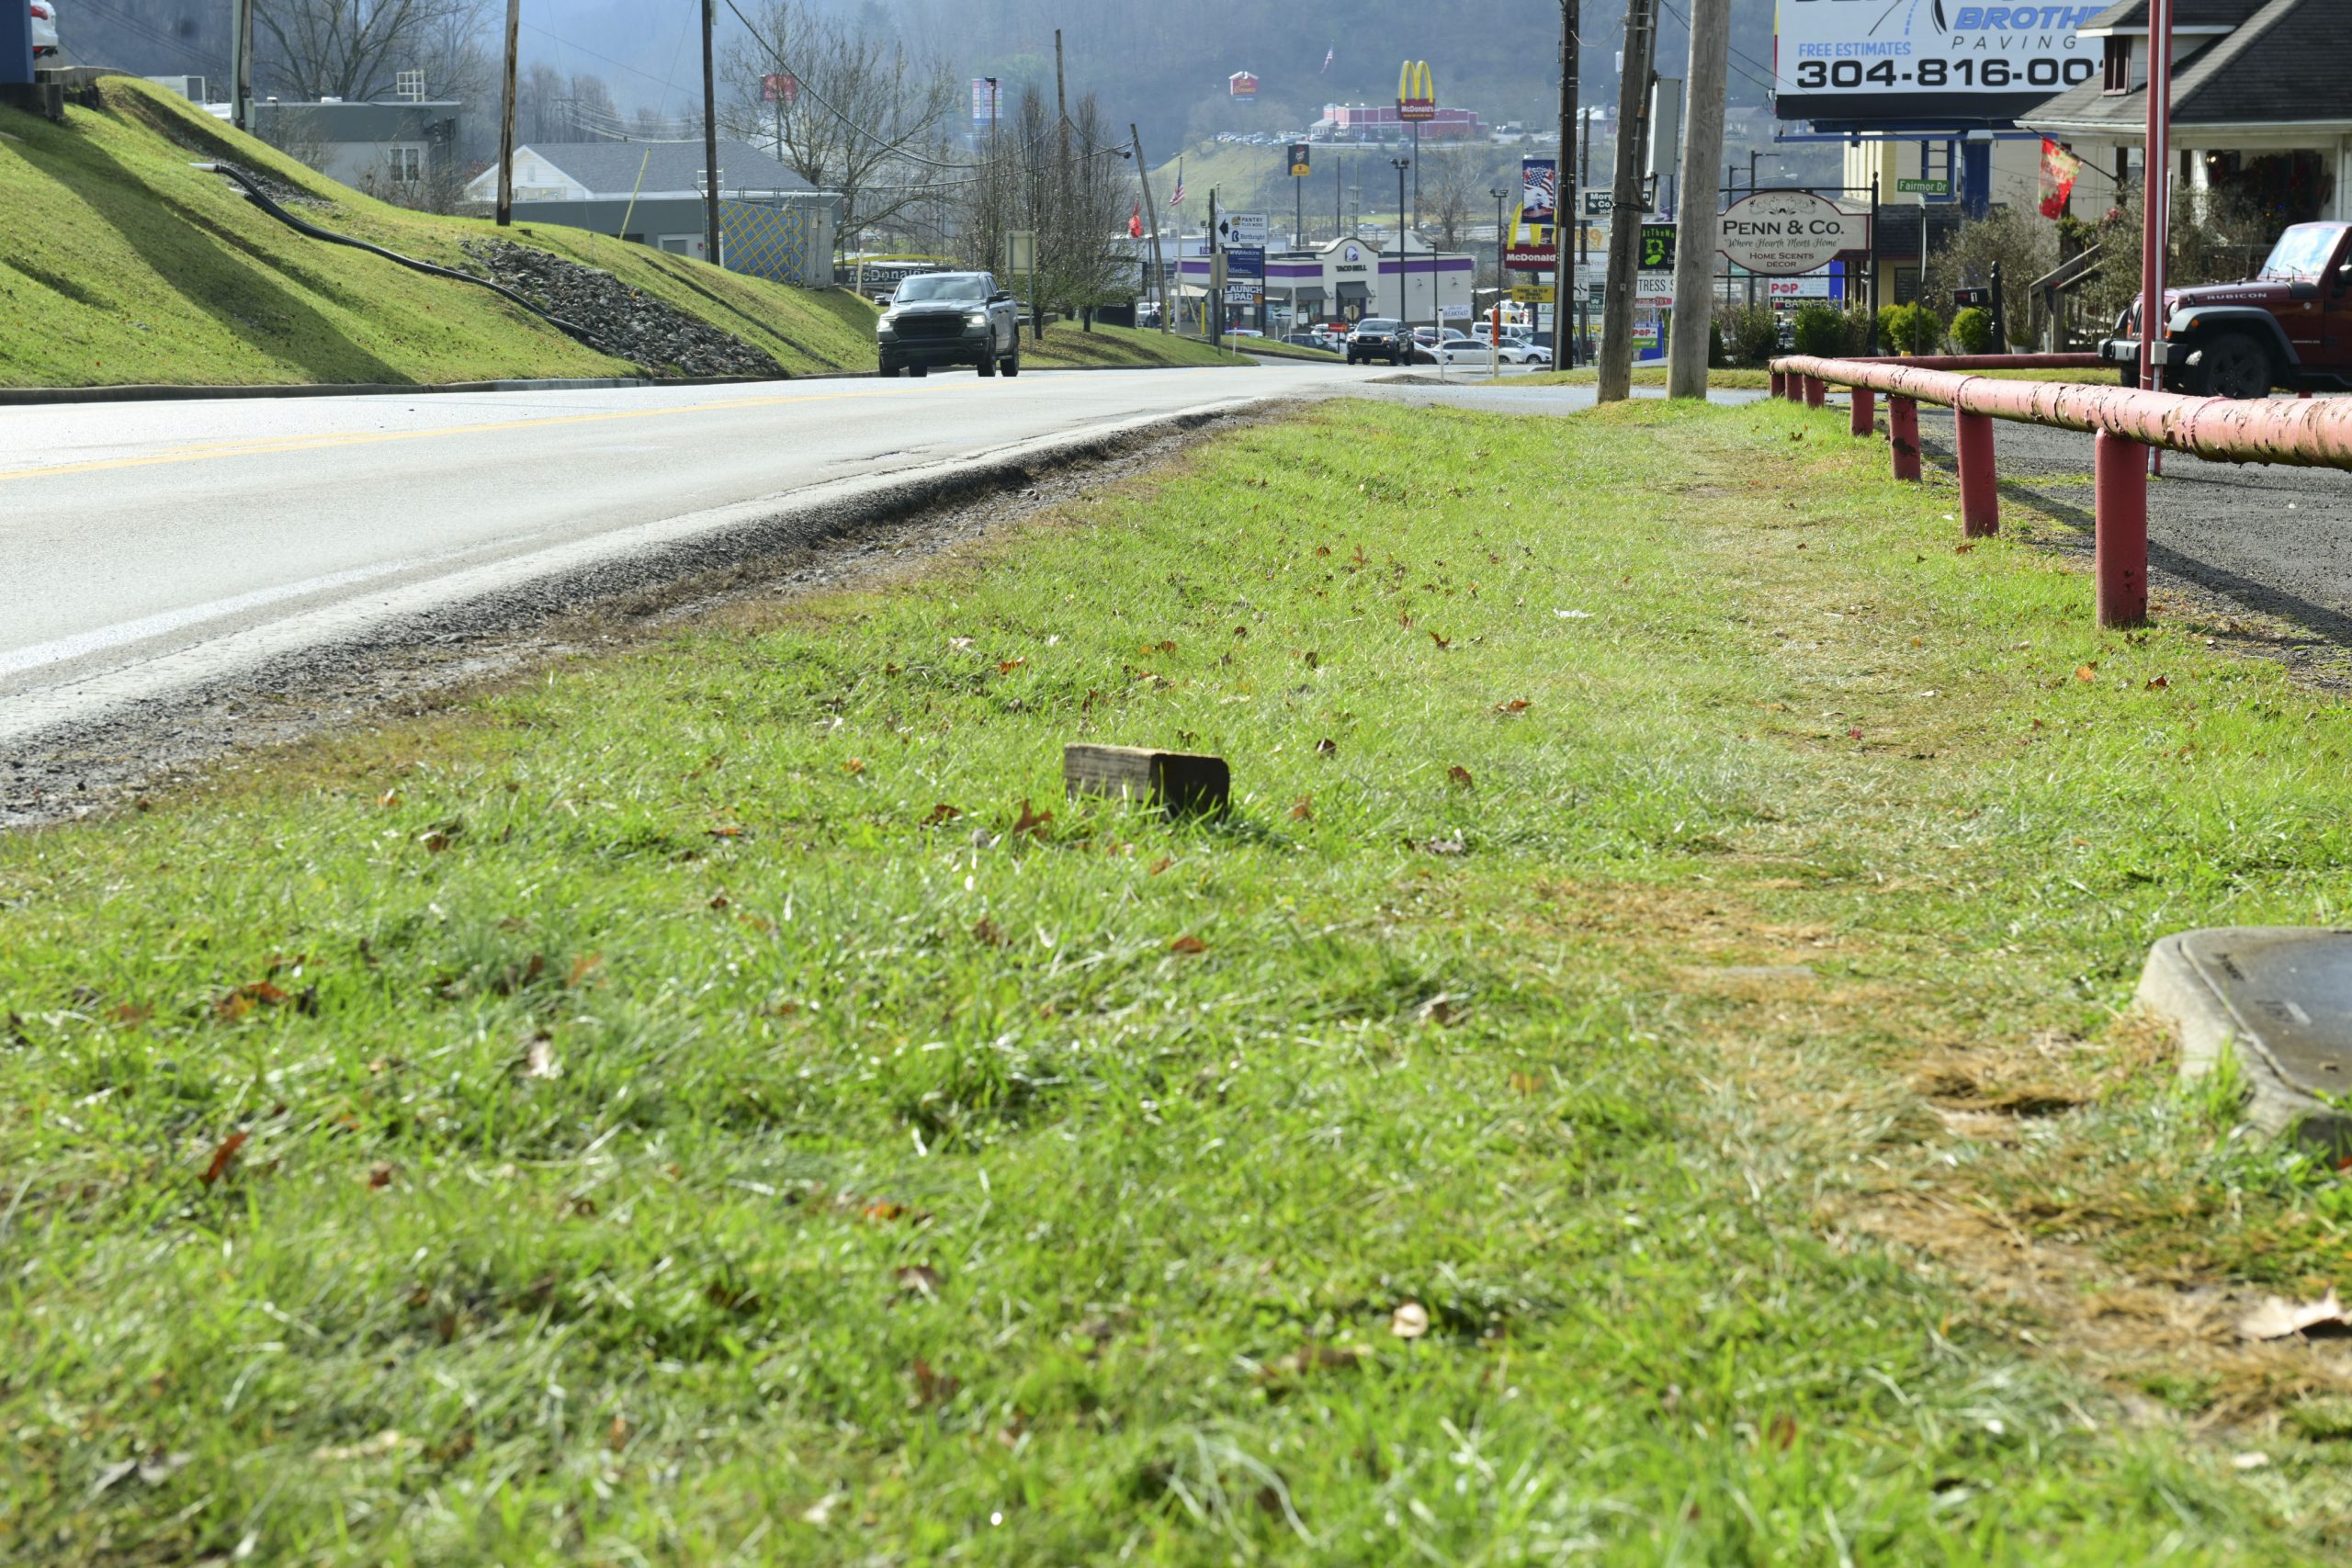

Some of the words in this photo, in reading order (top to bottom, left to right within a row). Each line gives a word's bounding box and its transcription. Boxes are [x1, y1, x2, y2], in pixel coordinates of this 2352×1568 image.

[1951, 35, 2076, 50] PAVING
[1798, 43, 1832, 57] FREE
[1836, 41, 1912, 56] ESTIMATES
[1797, 58, 2104, 88] 304-816-00
[1899, 180, 1935, 191] Fairmor
[1937, 182, 1947, 192] Dr
[1723, 220, 1781, 235] PENN
[1787, 220, 1804, 235] &
[1755, 238, 1784, 249] Hearth
[1787, 238, 1811, 248] Meets
[1779, 252, 1815, 260] SCENTS
[1225, 286, 1262, 294] LAUNCH
[2207, 292, 2267, 300] RUBICON
